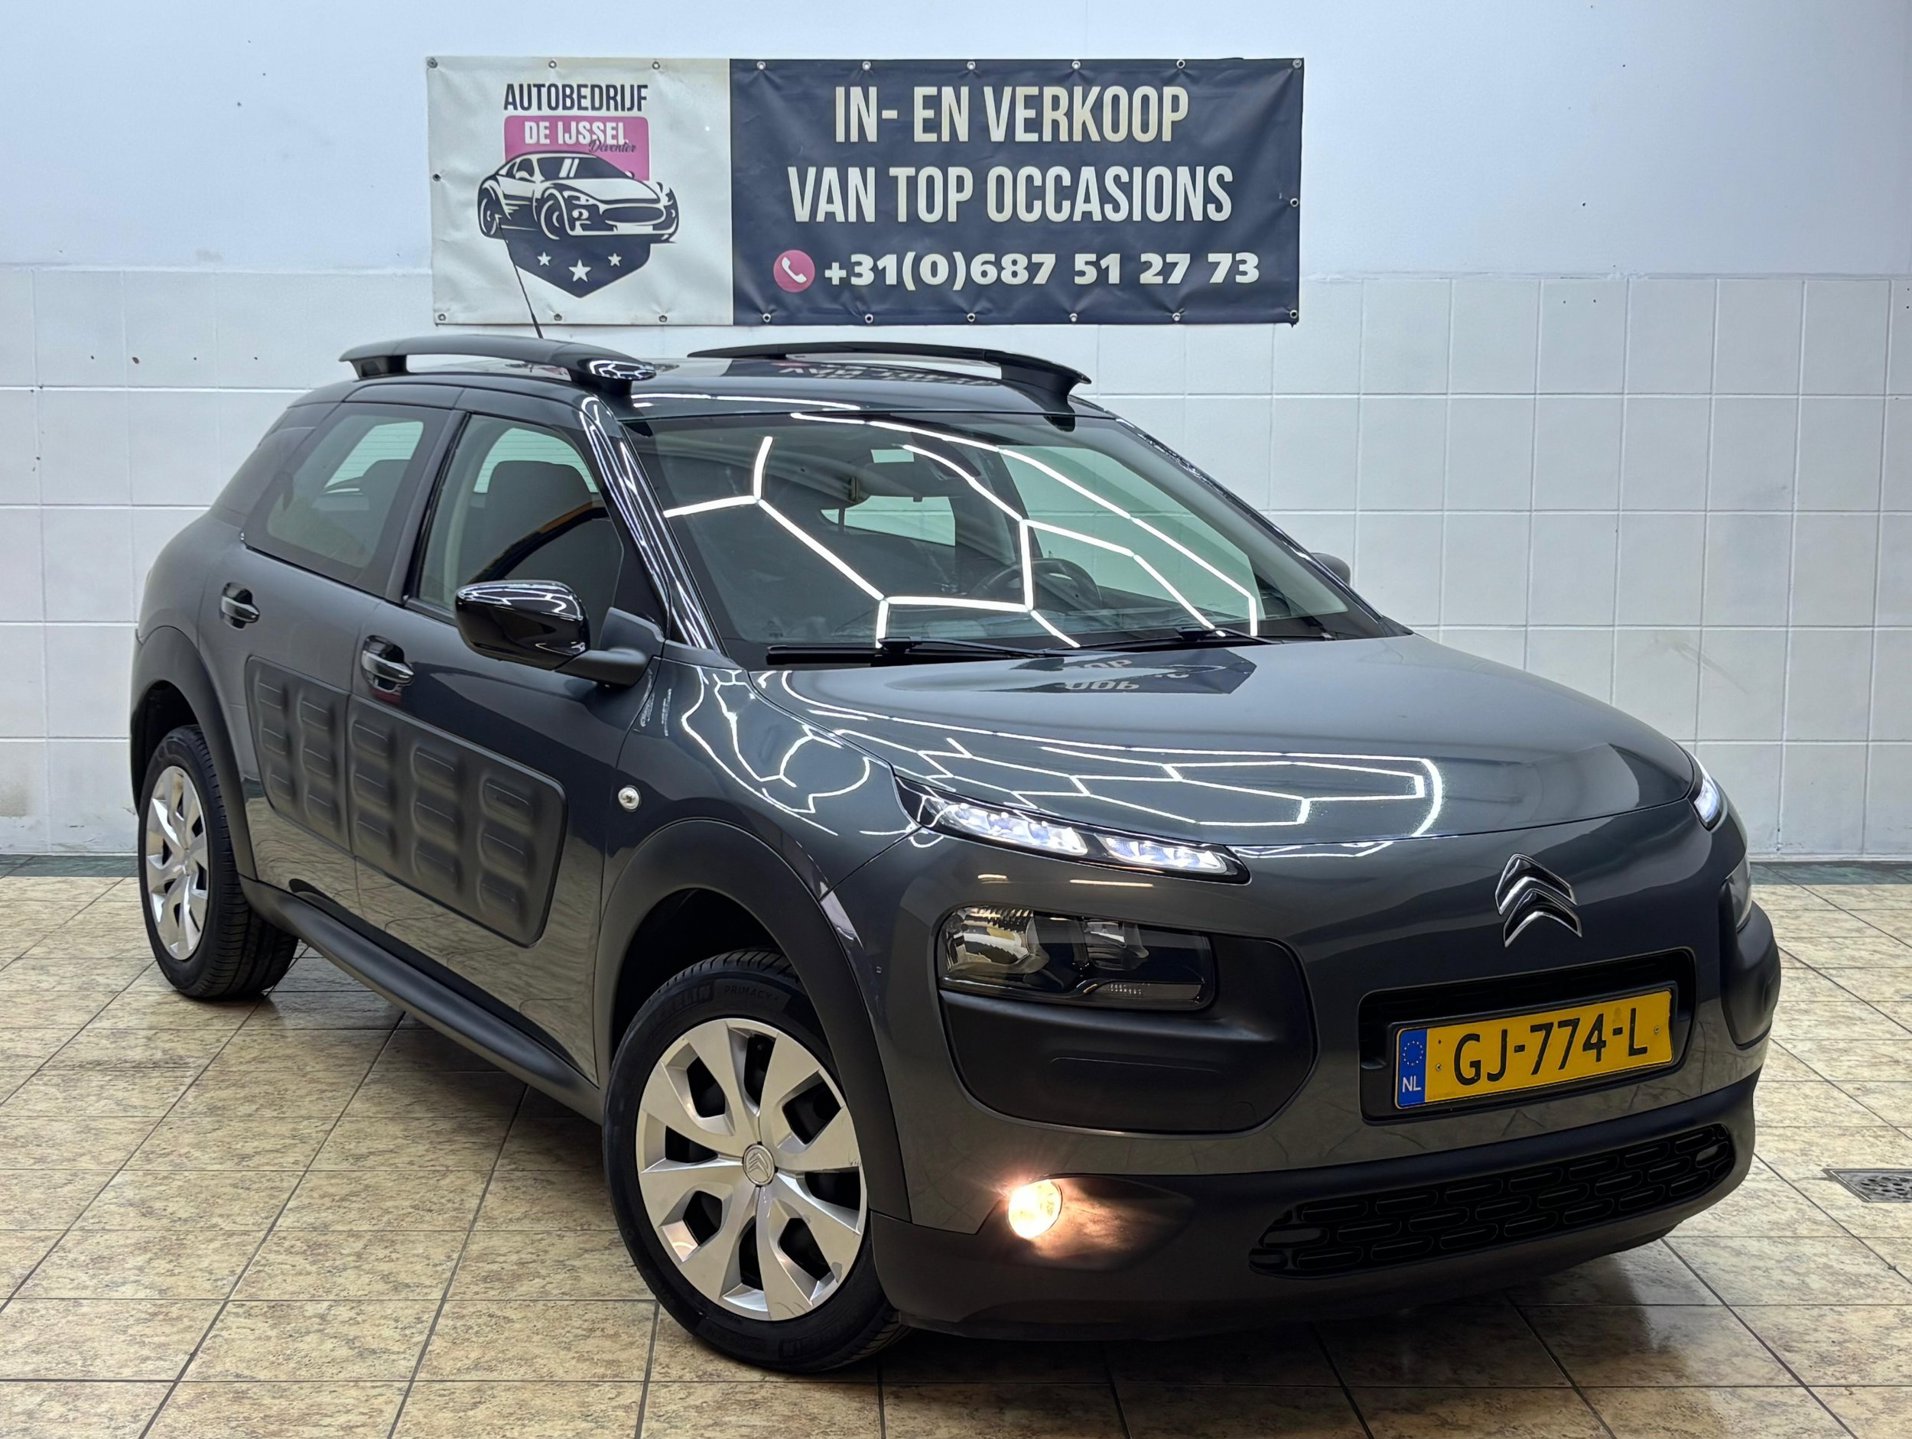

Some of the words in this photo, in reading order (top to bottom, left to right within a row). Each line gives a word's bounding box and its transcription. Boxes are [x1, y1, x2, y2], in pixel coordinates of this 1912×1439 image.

[503, 83, 649, 112] AUTOBEDRIJF
[834, 85, 899, 143] IN-
[913, 86, 969, 143] EN
[983, 86, 1190, 143] VERKOOP
[524, 121, 550, 145] DE
[557, 121, 629, 146] IJSSEL
[787, 166, 876, 223] VAN
[889, 166, 974, 223] TOP
[986, 165, 1234, 223] OCCASIONS
[823, 251, 1057, 291] +31(0)687
[1073, 253, 1121, 285] 51
[1139, 253, 1191, 285] 27
[1207, 253, 1260, 285] 73
[1453, 1007, 1648, 1086] GJ-774-L
[1402, 1075, 1422, 1093] NL
